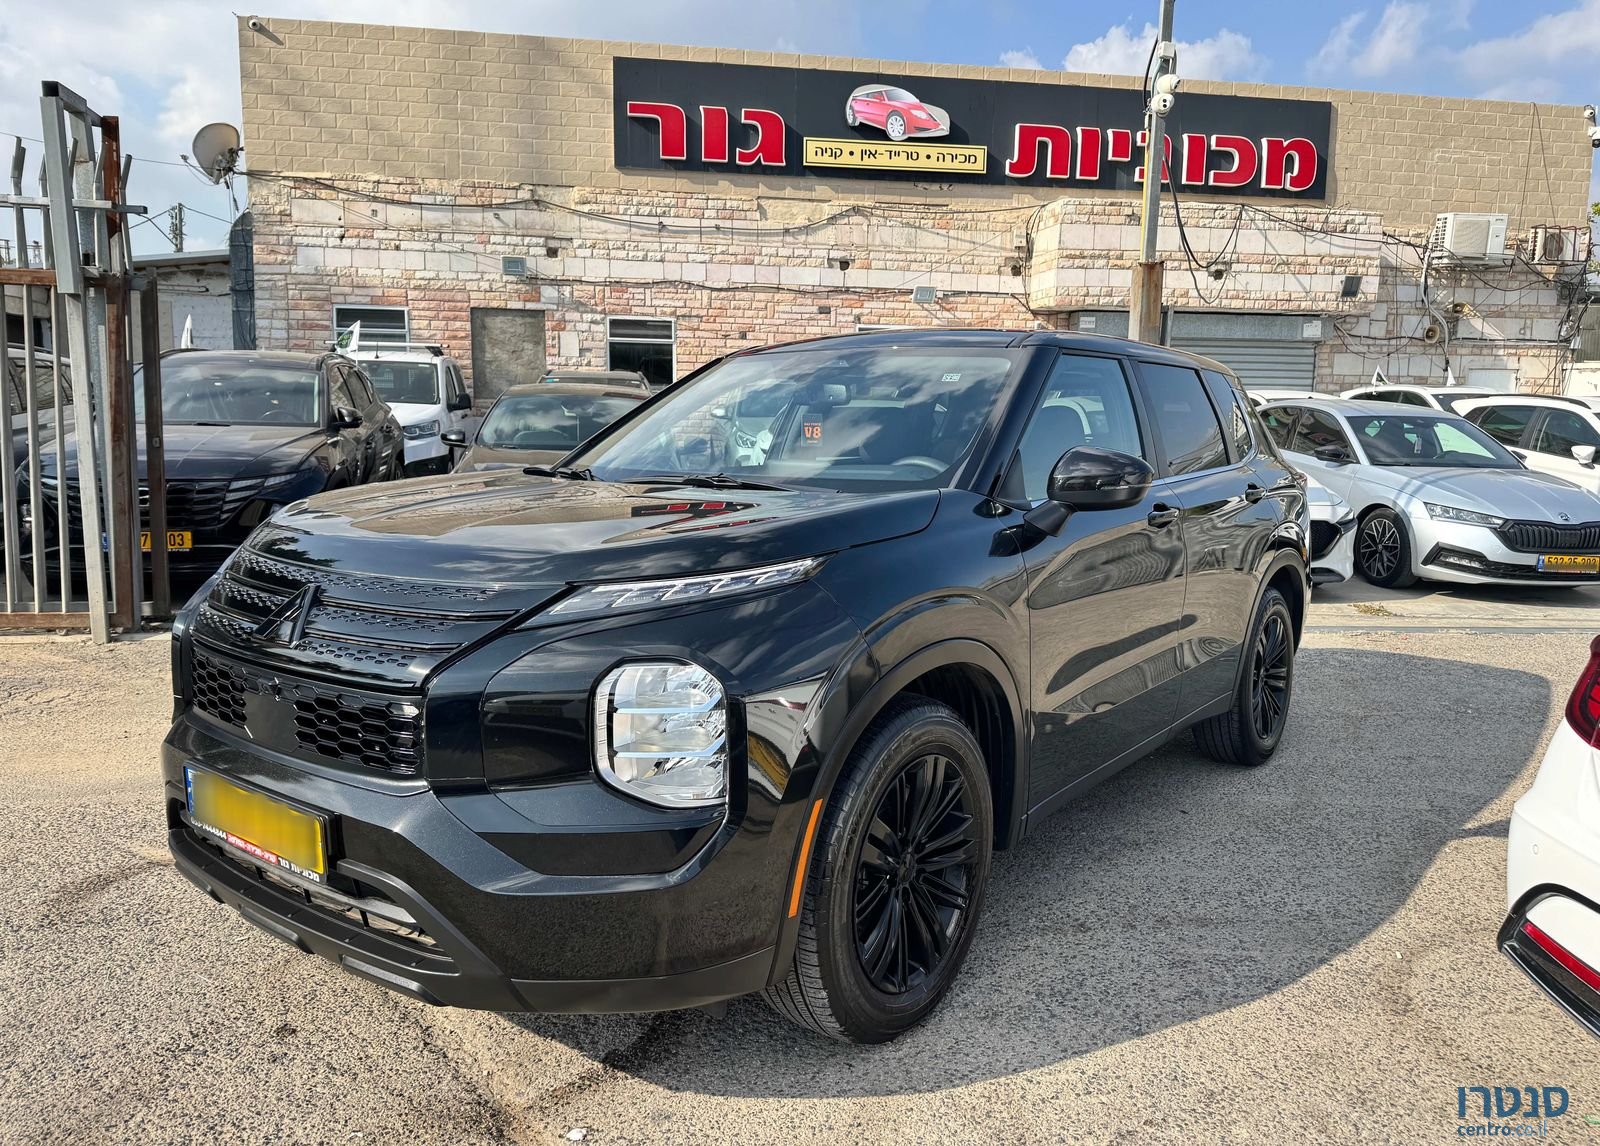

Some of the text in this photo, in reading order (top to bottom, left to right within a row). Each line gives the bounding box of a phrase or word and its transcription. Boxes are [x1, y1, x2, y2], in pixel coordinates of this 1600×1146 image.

[626, 101, 786, 167] גור
[814, 145, 978, 165] מכירה טרייד-אין קניה
[804, 426, 821, 439] V8
